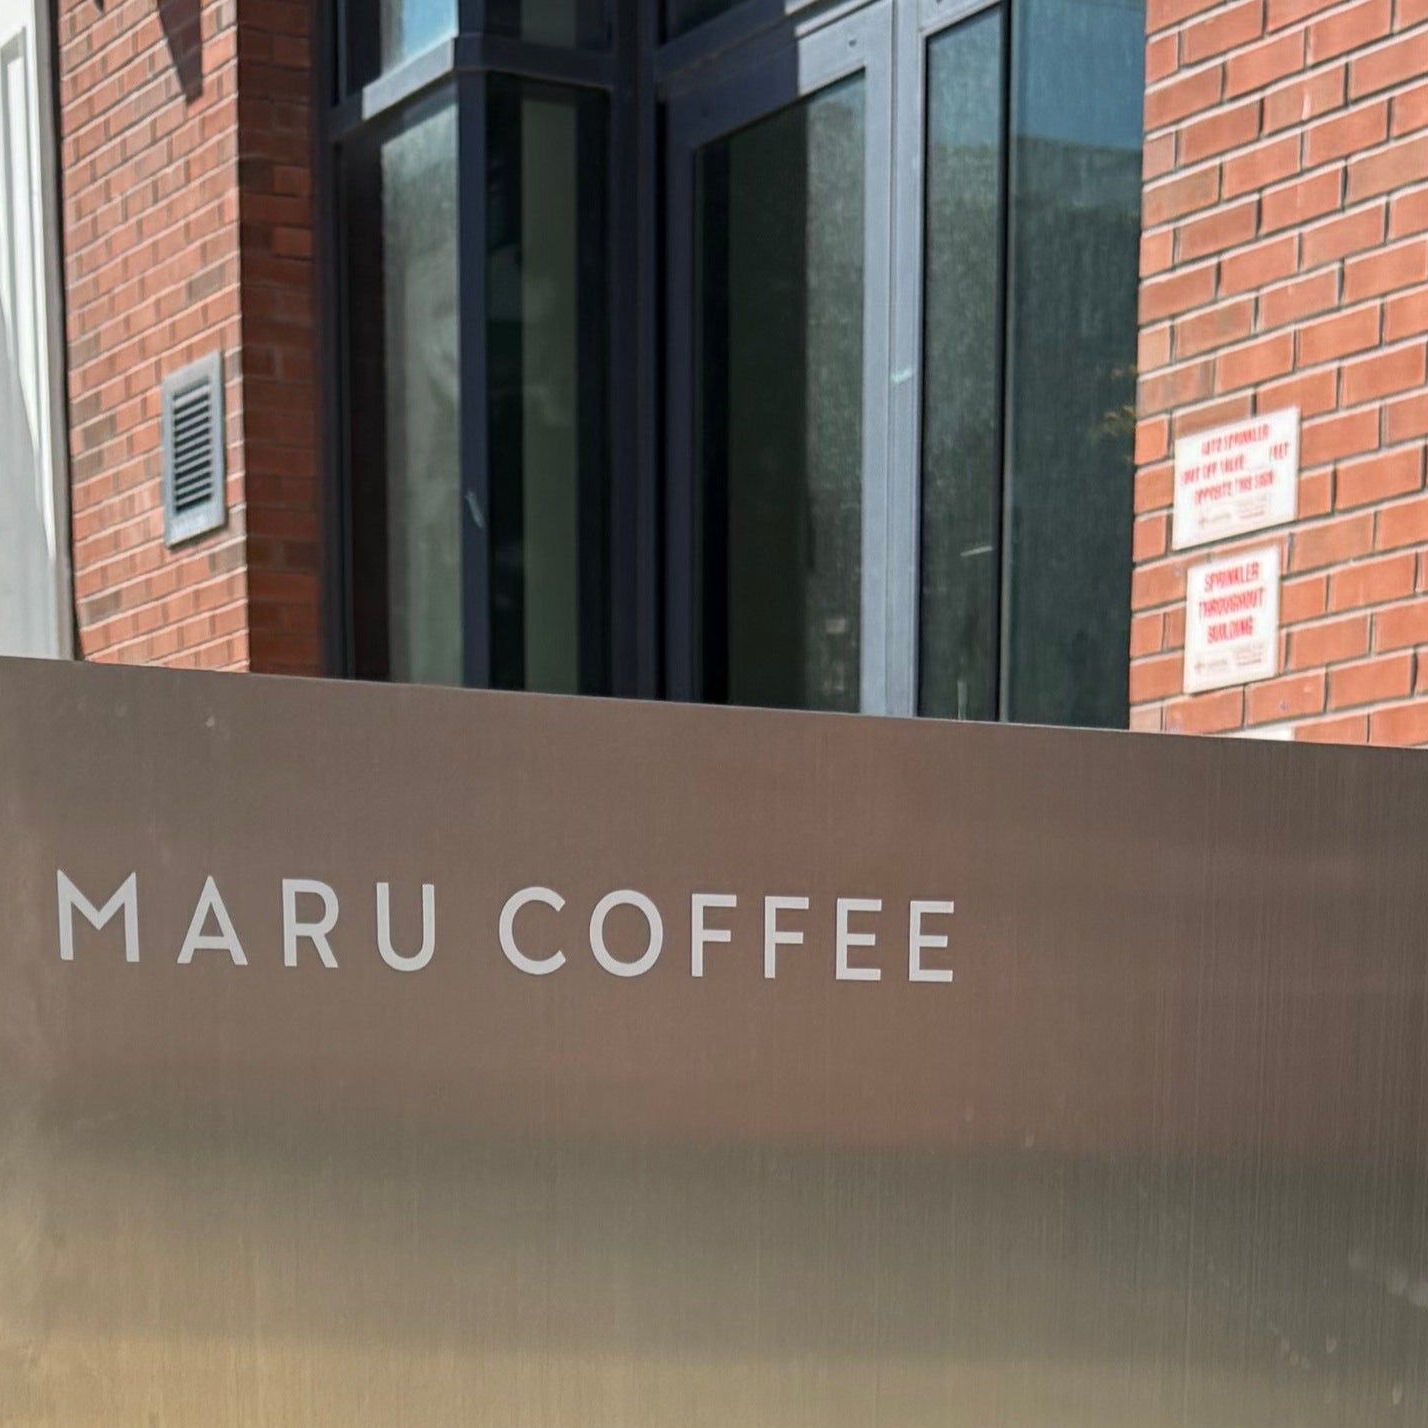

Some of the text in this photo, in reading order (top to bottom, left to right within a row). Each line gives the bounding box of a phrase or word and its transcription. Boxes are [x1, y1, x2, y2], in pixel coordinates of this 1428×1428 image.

[1204, 561, 1259, 592] SPRINKLER
[55, 868, 955, 983] MARU COFFEE
